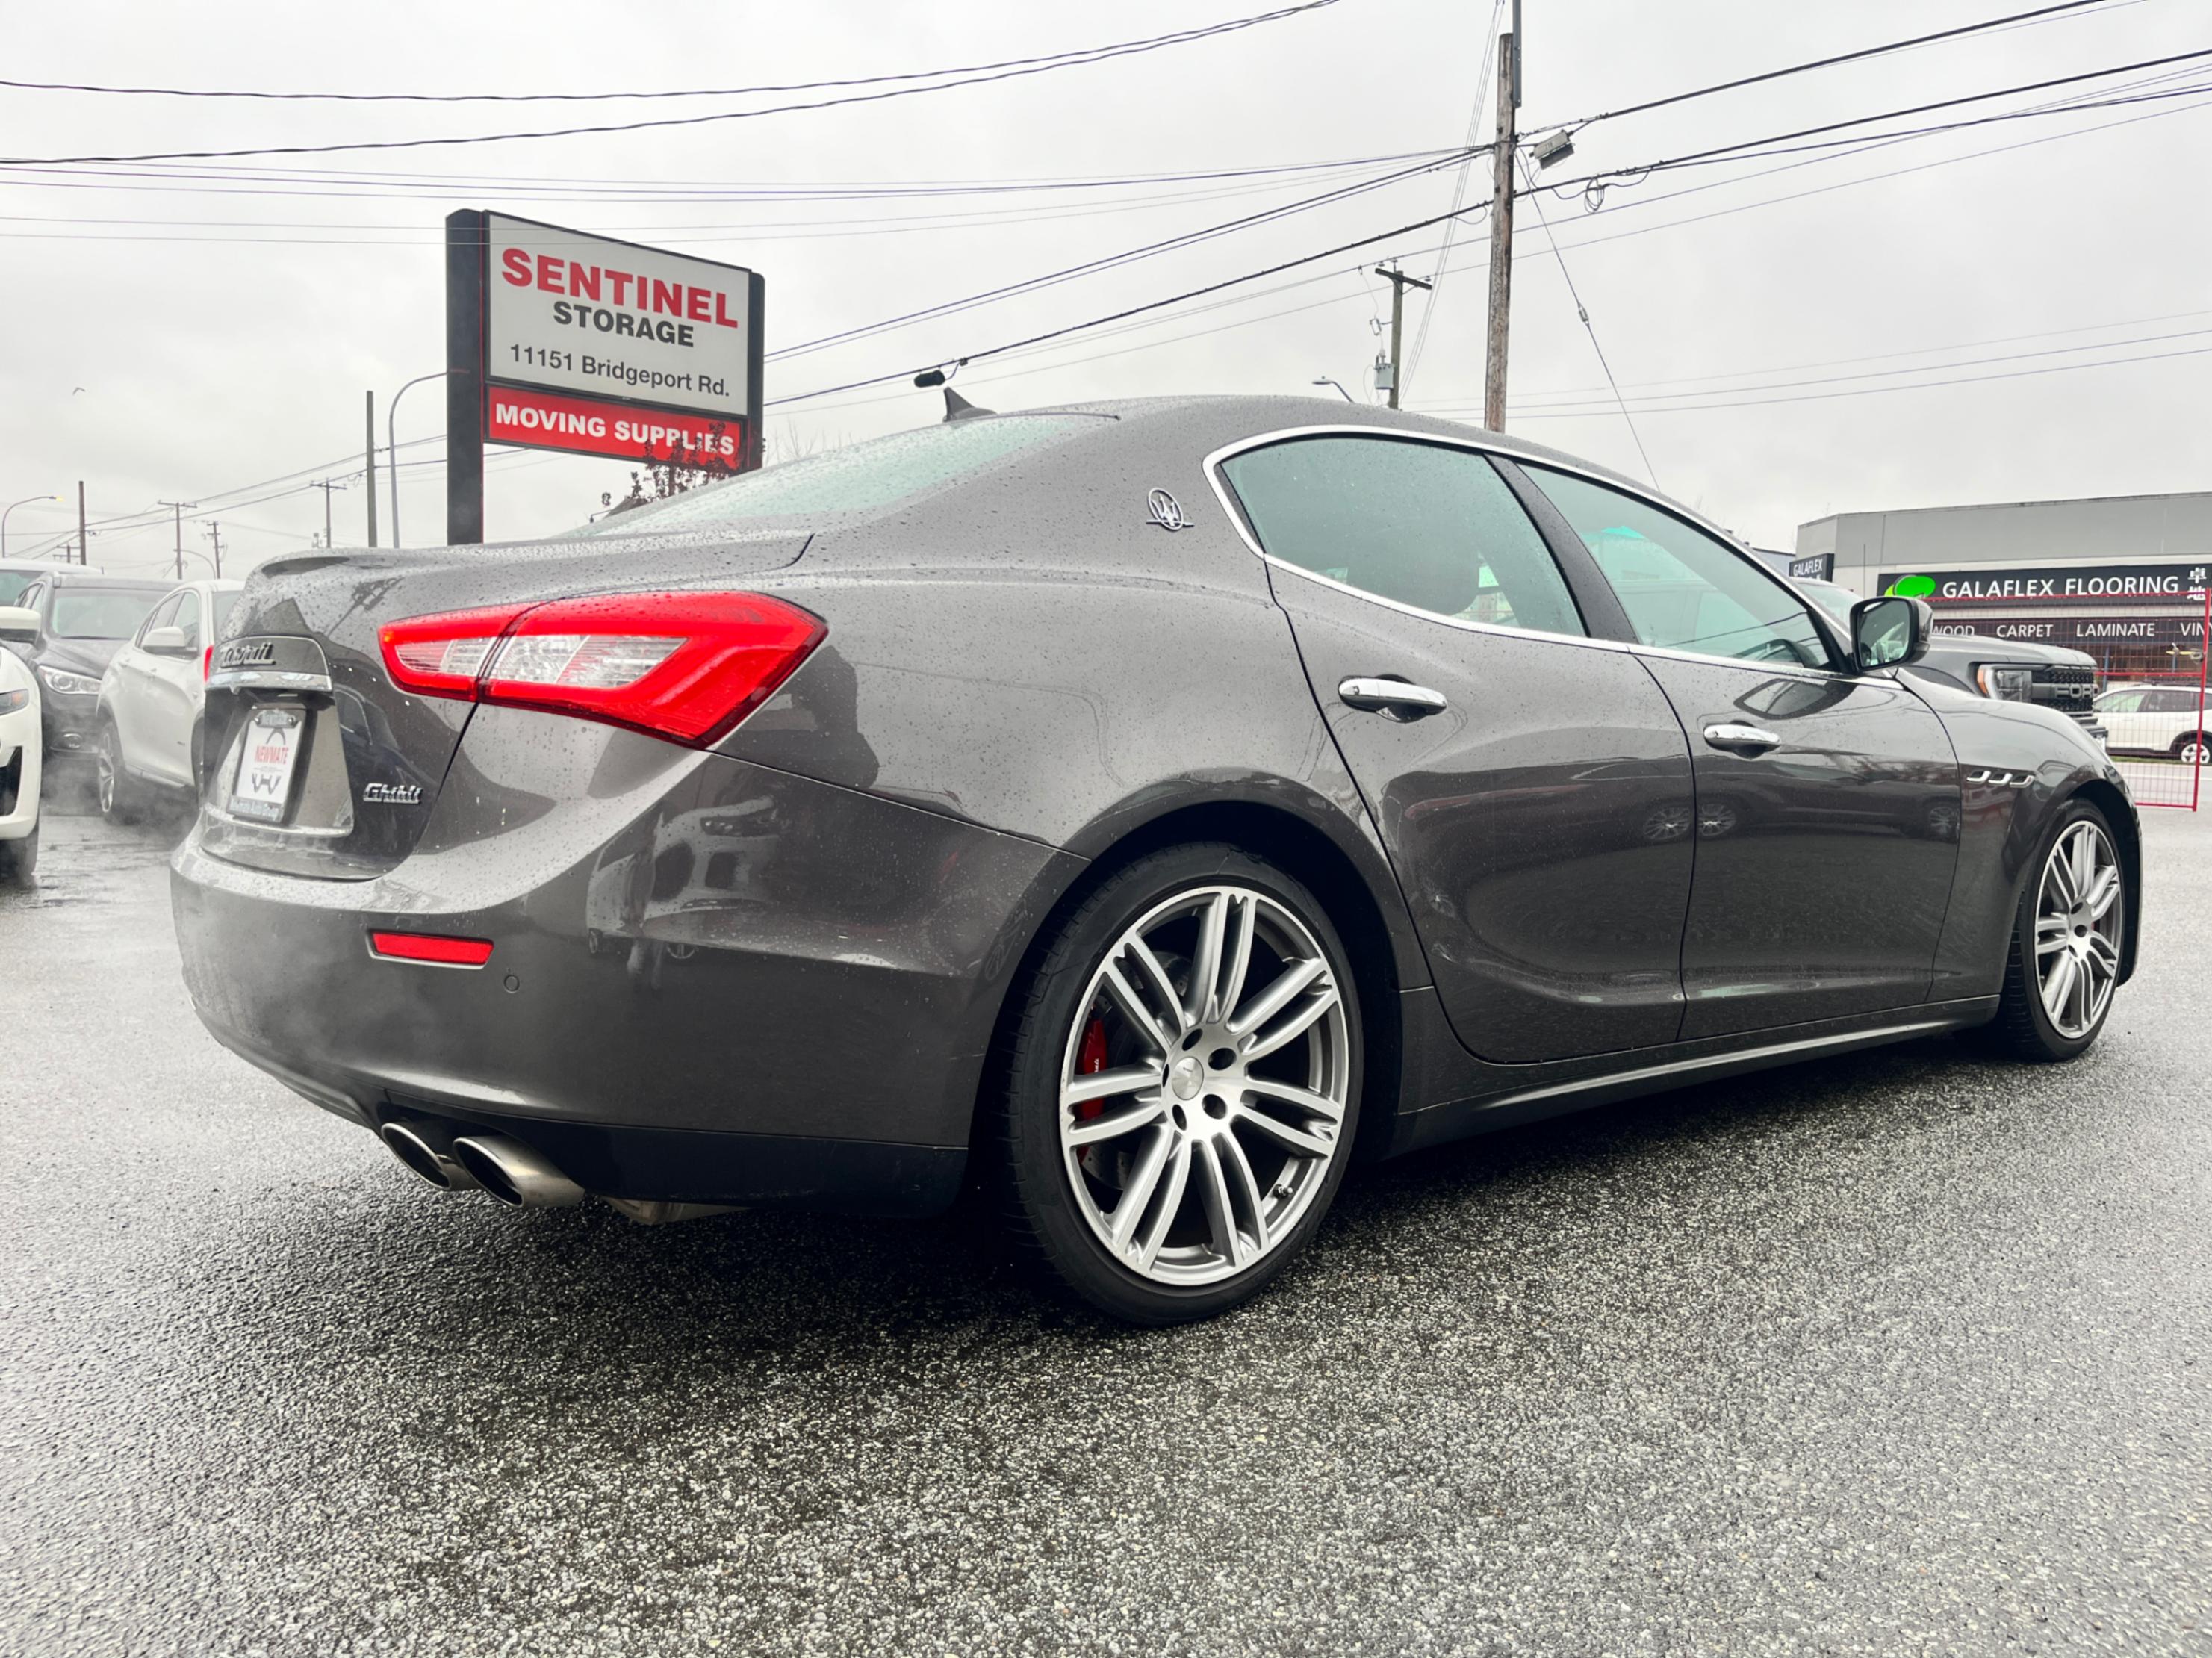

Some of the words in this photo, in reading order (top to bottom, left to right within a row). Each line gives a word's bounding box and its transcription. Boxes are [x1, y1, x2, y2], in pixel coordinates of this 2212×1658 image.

[502, 248, 738, 329] SENTINEL
[553, 301, 694, 347] STORAGE
[511, 344, 572, 371] 11151
[582, 355, 692, 391] Bridgeport
[698, 375, 730, 397] Rd.
[496, 403, 606, 438] MOVING
[615, 420, 735, 456] SUPPLIES
[1793, 559, 1823, 577] GALAFLEX
[1942, 579, 2054, 597] GALAFLEX
[2065, 576, 2179, 595] FLOORING
[1996, 624, 2054, 637] CARPET
[2076, 623, 2156, 637] LAMINATE
[2180, 622, 2212, 636] VIN
